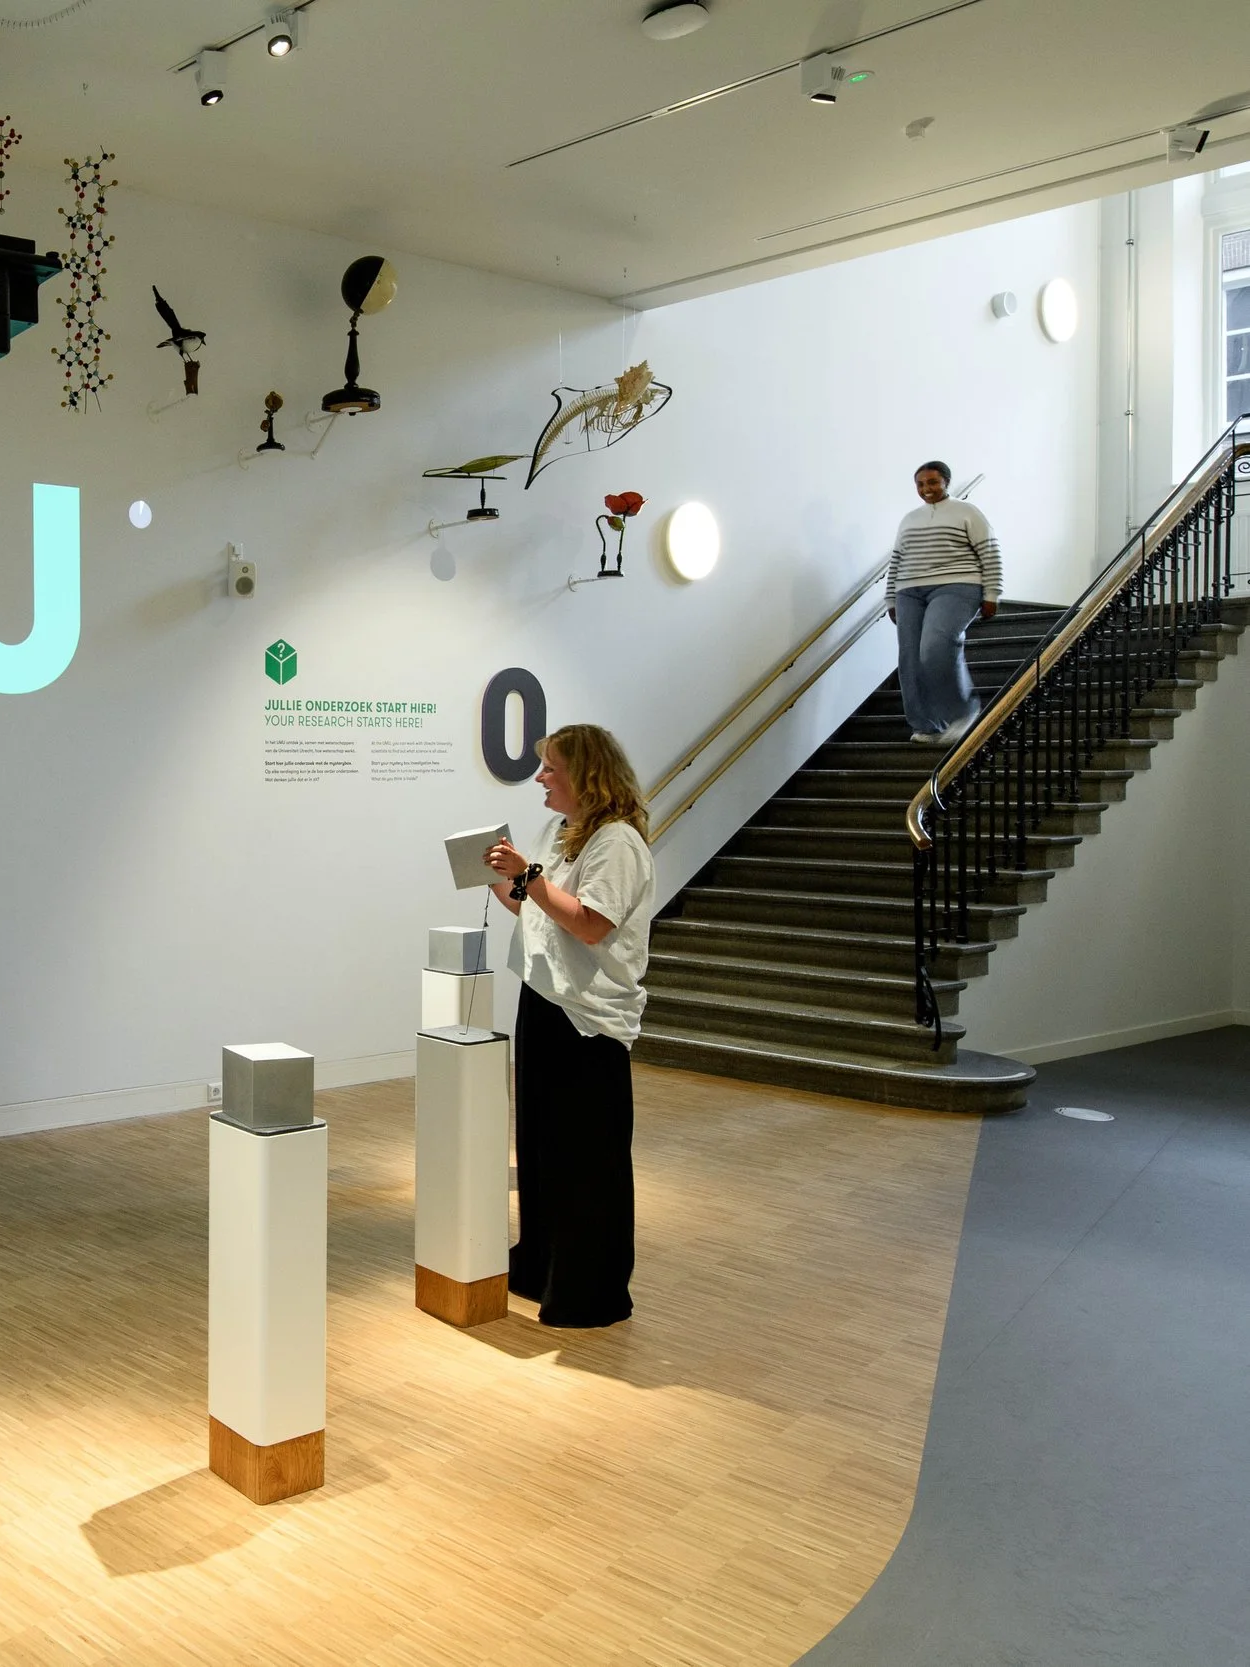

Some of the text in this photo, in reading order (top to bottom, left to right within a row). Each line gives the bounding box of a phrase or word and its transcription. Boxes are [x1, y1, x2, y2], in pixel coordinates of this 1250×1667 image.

[264, 699, 437, 714] JULLIE ONDERZOEK START HIER!
[264, 715, 423, 728] YOUR RESEARCH STARTS HERE!
